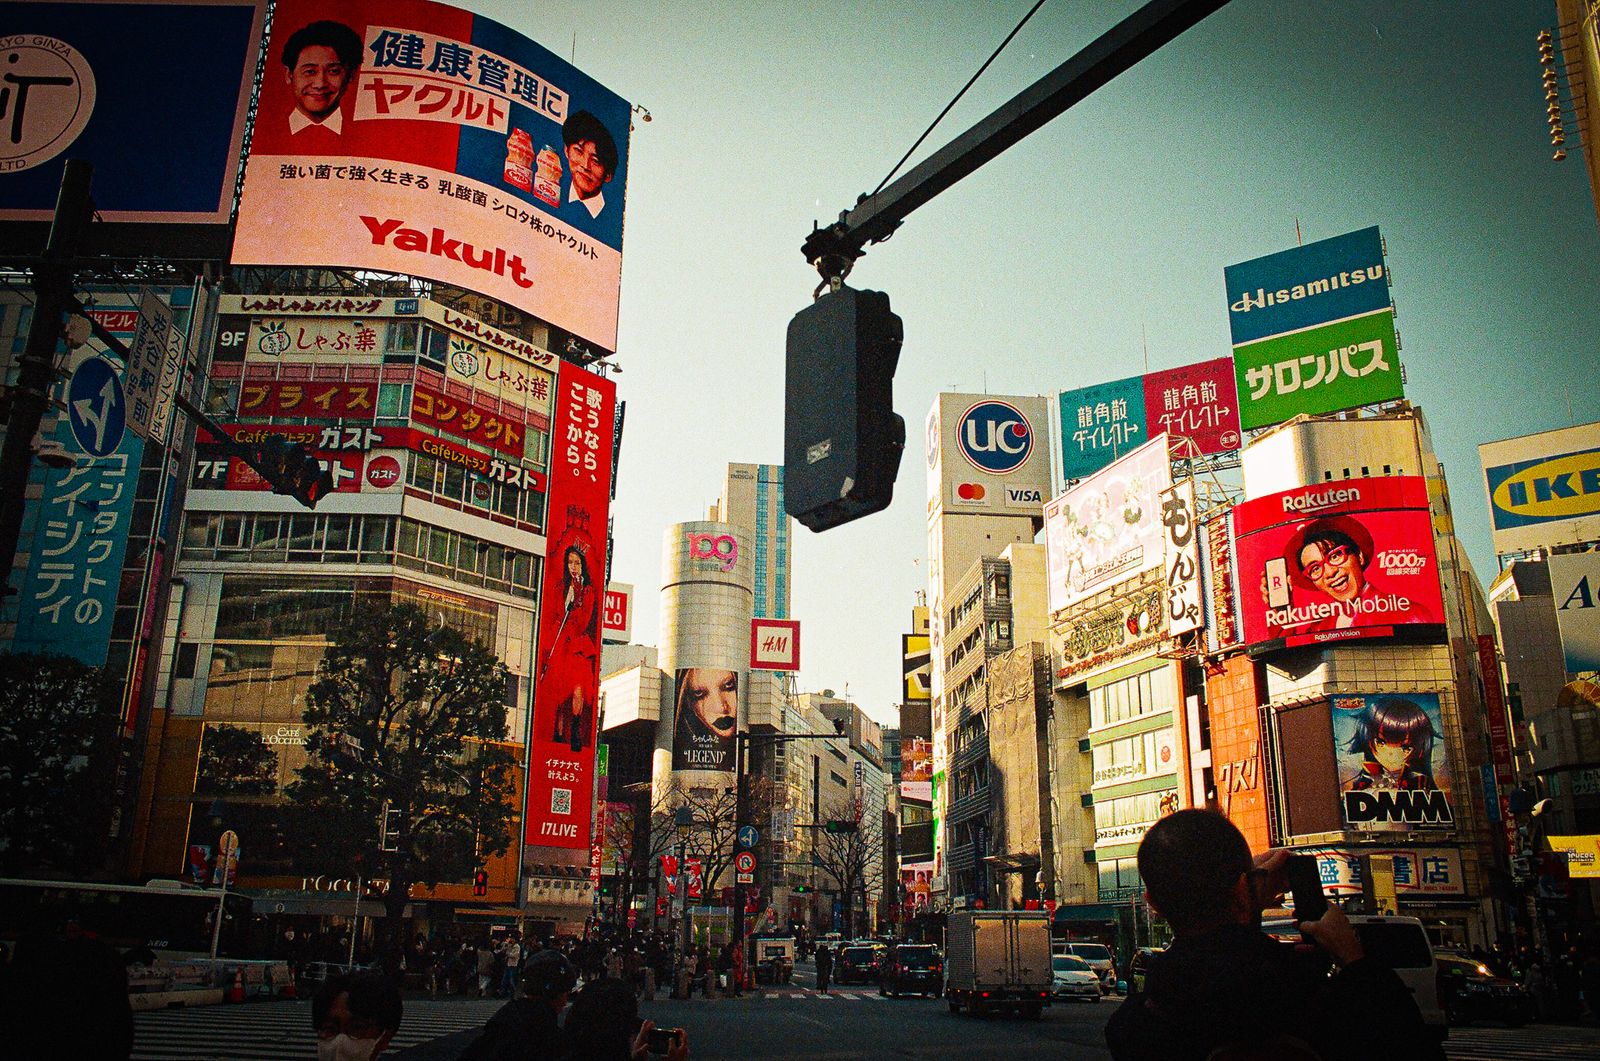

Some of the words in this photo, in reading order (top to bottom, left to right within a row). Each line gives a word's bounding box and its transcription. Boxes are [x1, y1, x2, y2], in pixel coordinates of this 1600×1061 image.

[32, 36, 72, 58] GINZA
[370, 29, 564, 118] 健康管理に
[362, 79, 505, 126] ヤクルト
[279, 163, 430, 191] 強い菌で強く生きる
[438, 180, 489, 210] 乳酸菌
[491, 197, 600, 262] シロタ株のヤクルト
[359, 214, 535, 290] Yakult
[1230, 264, 1383, 313] Hisamitsu
[240, 296, 383, 314] しゃぶしゃぶバイキング
[220, 331, 246, 348] 9F
[296, 327, 377, 353] しゃぶ葉
[443, 309, 555, 365] しゃぶしゃぶバイキング
[484, 356, 550, 401] しゃぶ葉
[1244, 338, 1390, 402] サロンパス
[244, 384, 373, 411] プライス
[1163, 380, 1218, 411] 龍角散
[413, 390, 521, 447] コンタクト
[1076, 397, 1128, 429] 龍角散
[1158, 404, 1231, 435] ダイレクト
[319, 426, 384, 450] ガスト
[566, 381, 585, 478] ここから。
[583, 387, 603, 483] 歌うなら、
[1072, 421, 1139, 452] ダイレクト
[197, 460, 229, 480] 7F
[370, 469, 398, 480] ガスト
[489, 458, 538, 491] ガスト
[1007, 489, 1042, 502] VISA
[1282, 486, 1361, 513] Rakuten
[35, 454, 97, 624] アイシティ
[75, 452, 129, 625] コンタクトの
[685, 532, 739, 572] 109
[1162, 488, 1200, 626] もんじゃ
[1266, 602, 1342, 629] Rakuten
[1346, 594, 1411, 615] Mobile
[761, 635, 788, 654] H&M
[1314, 631, 1340, 641] Rakuten
[1340, 630, 1361, 638] Vision
[545, 758, 583, 772] イチナナで、
[1344, 789, 1454, 824] DMM
[540, 821, 578, 838] 17LIVE
